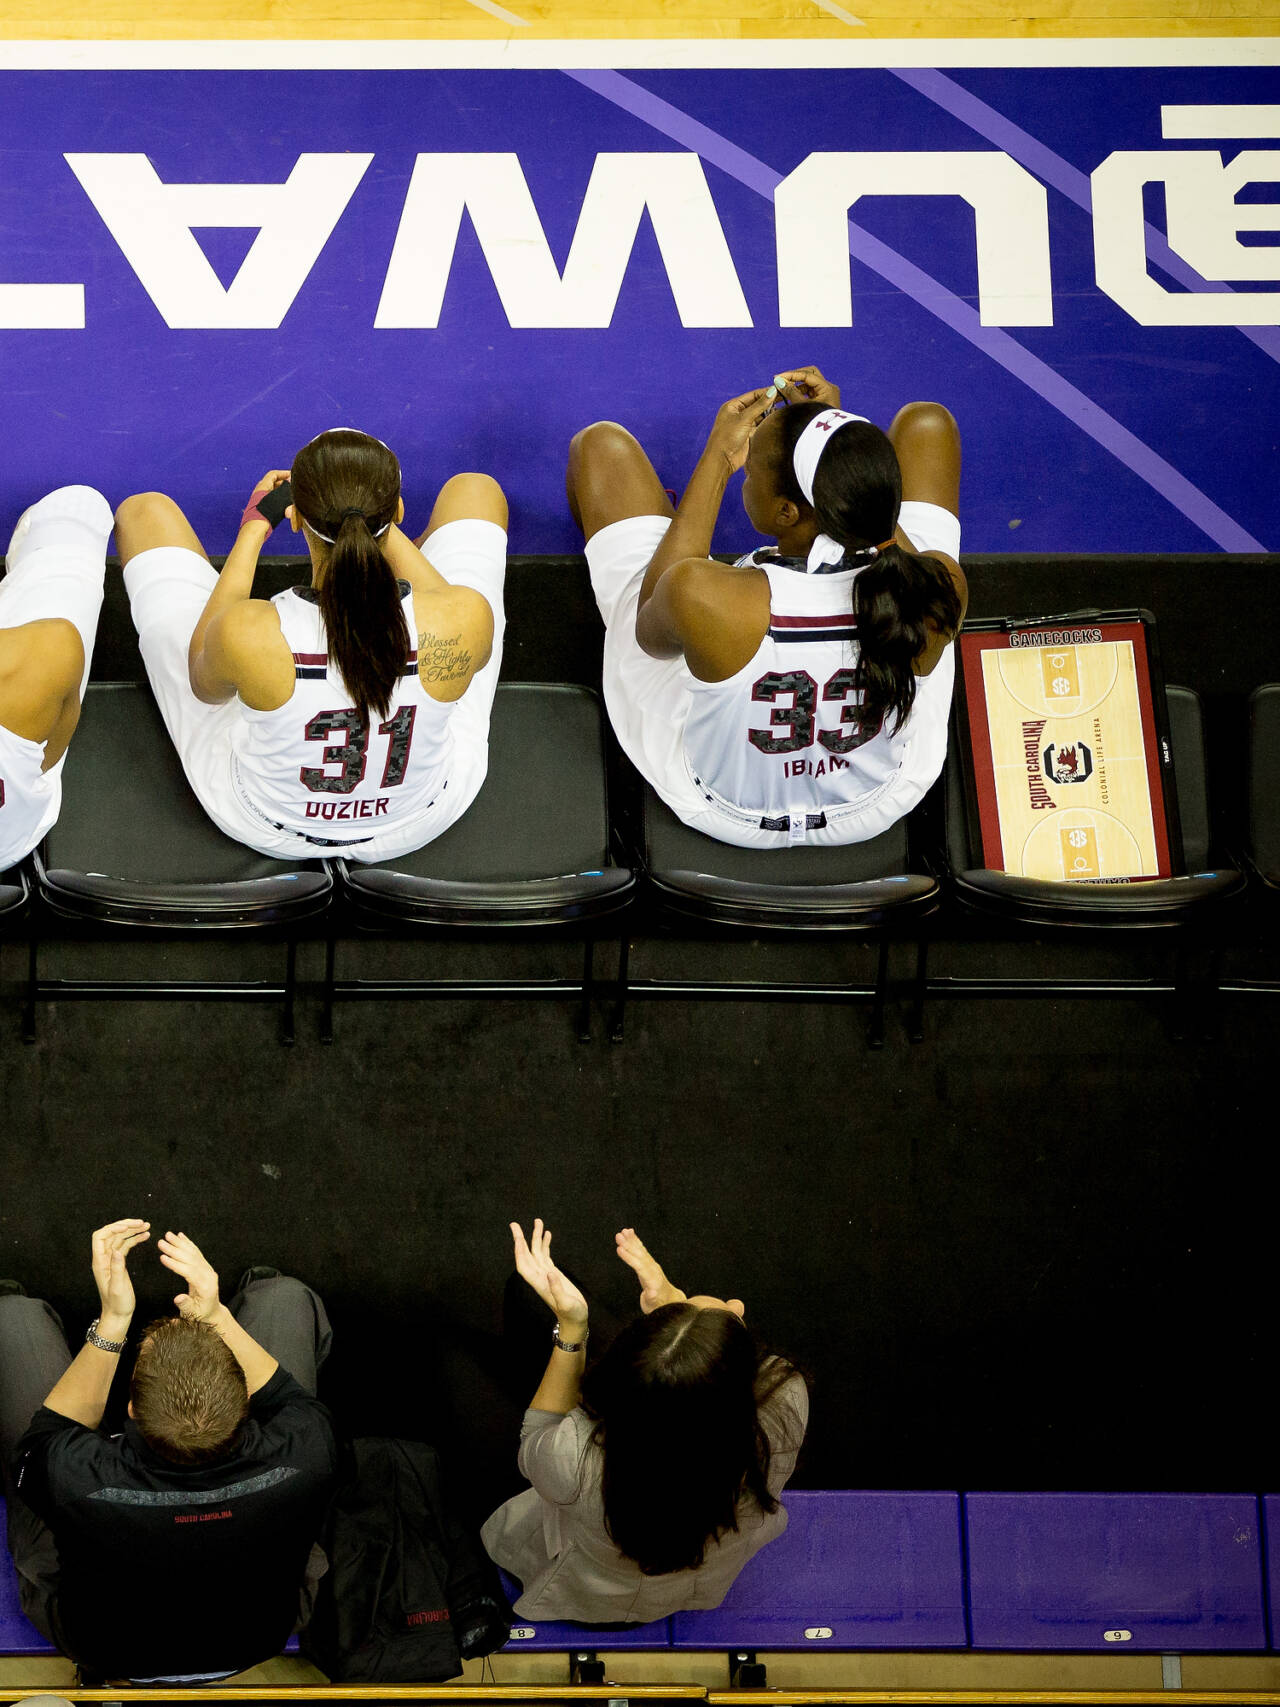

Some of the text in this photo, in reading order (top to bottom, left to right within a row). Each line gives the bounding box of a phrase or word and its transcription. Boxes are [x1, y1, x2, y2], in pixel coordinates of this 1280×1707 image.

[418, 632, 461, 650] Blessed
[1010, 629, 1102, 648] GAMECOCKS
[433, 648, 472, 672] Highly
[748, 669, 886, 755] 33
[300, 705, 417, 794] 31
[1093, 717, 1109, 805] COLONIAL LIFE ARENA
[784, 756, 850, 781] IBIAM
[1021, 719, 1056, 810] SOUTH CAROLINA
[305, 796, 390, 821] DOZIER
